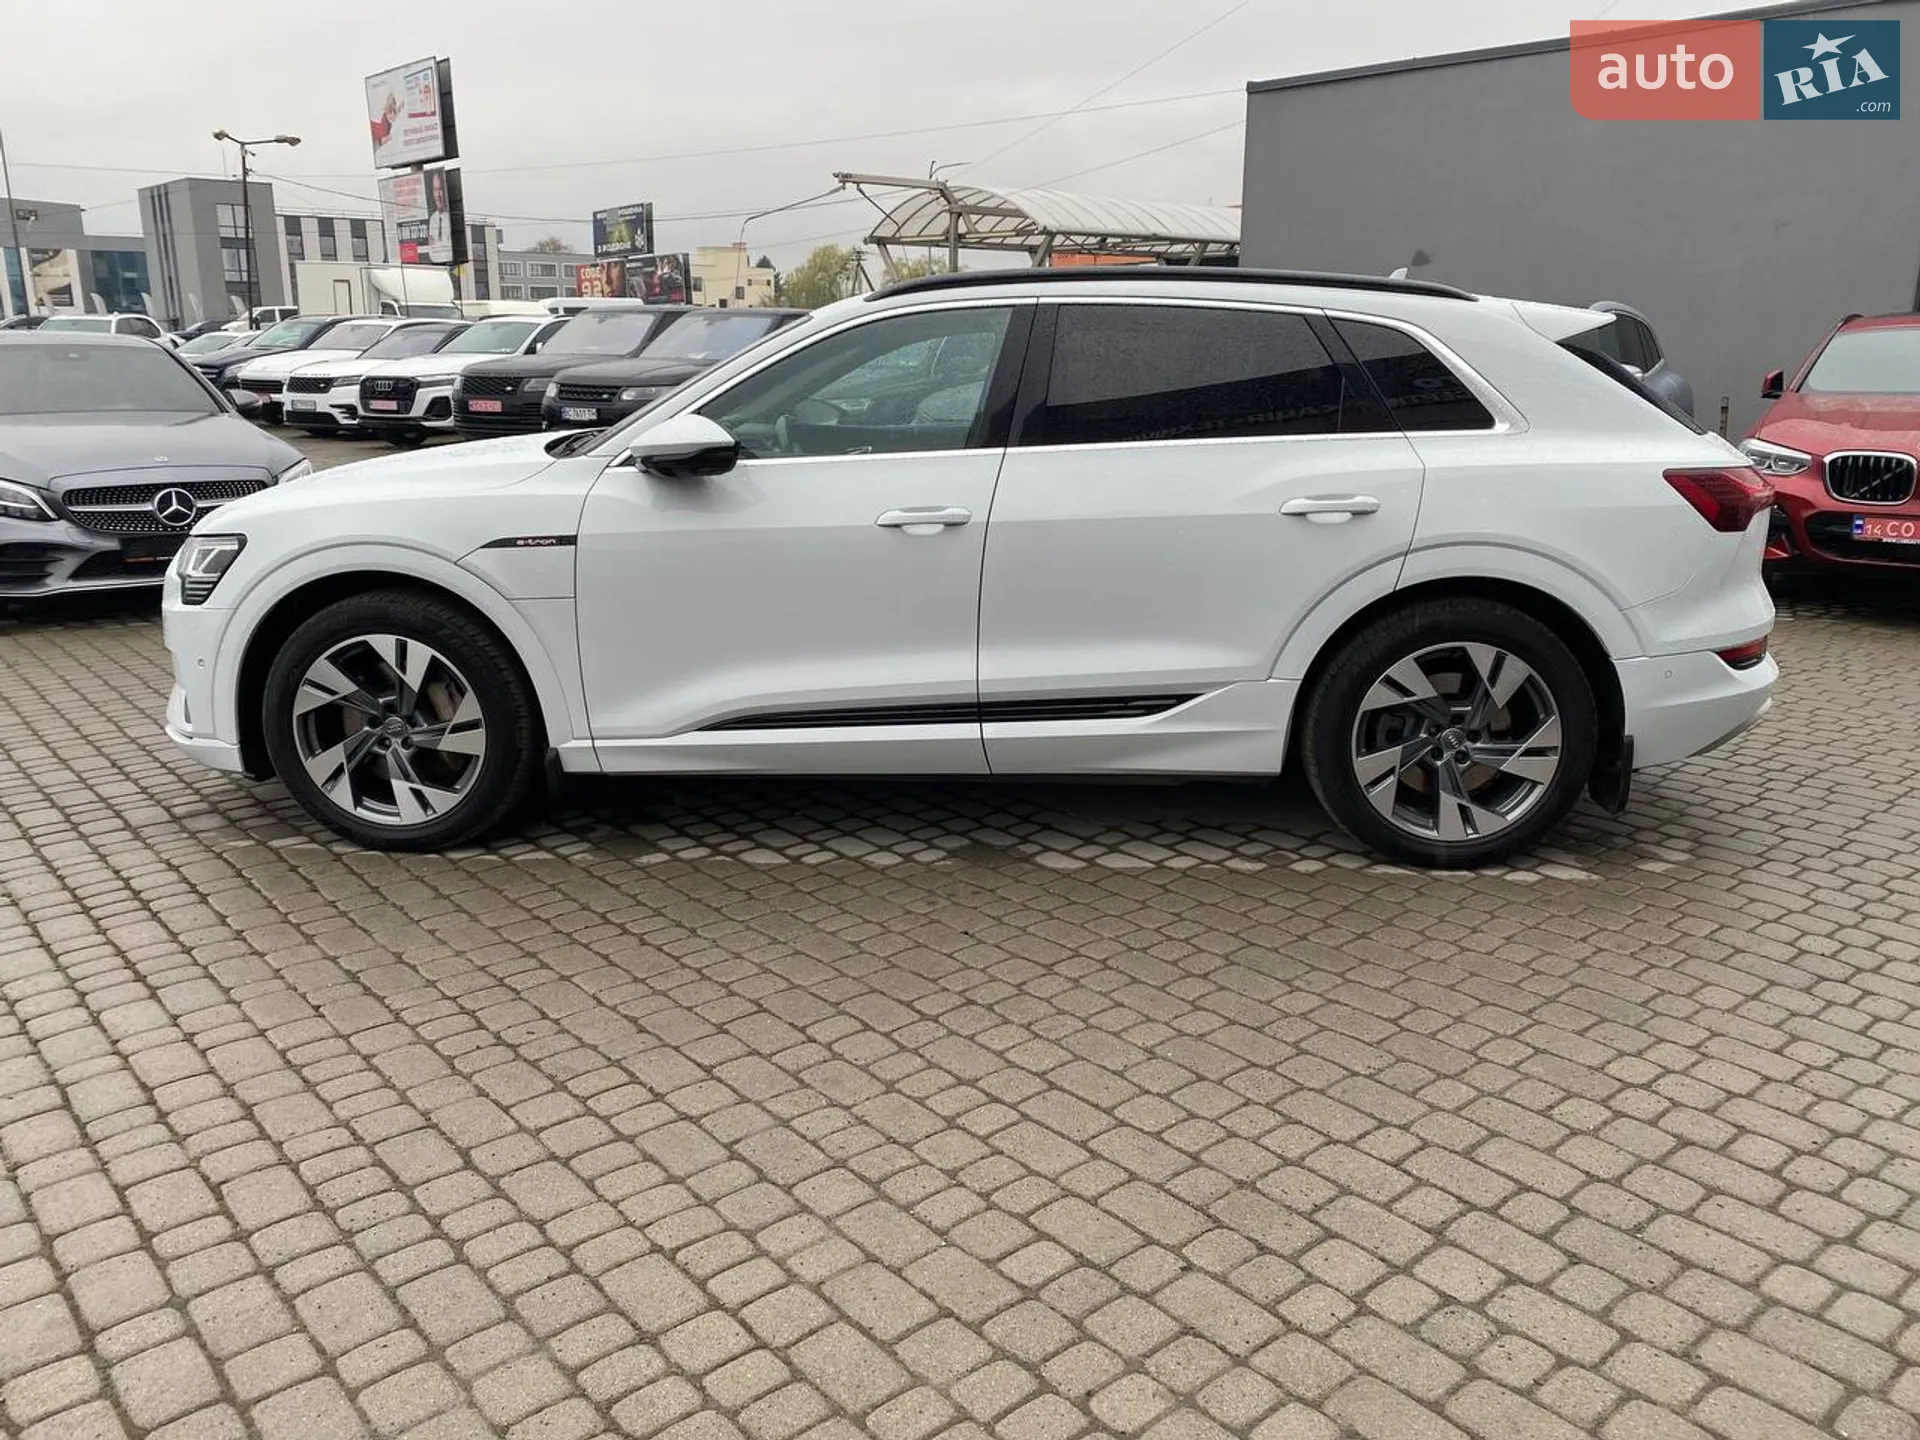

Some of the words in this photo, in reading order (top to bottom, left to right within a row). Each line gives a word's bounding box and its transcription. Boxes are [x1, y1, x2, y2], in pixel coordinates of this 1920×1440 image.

[1865, 524, 1883, 537] 14
[1886, 521, 1916, 538] CO
[516, 538, 557, 546] e-tron
